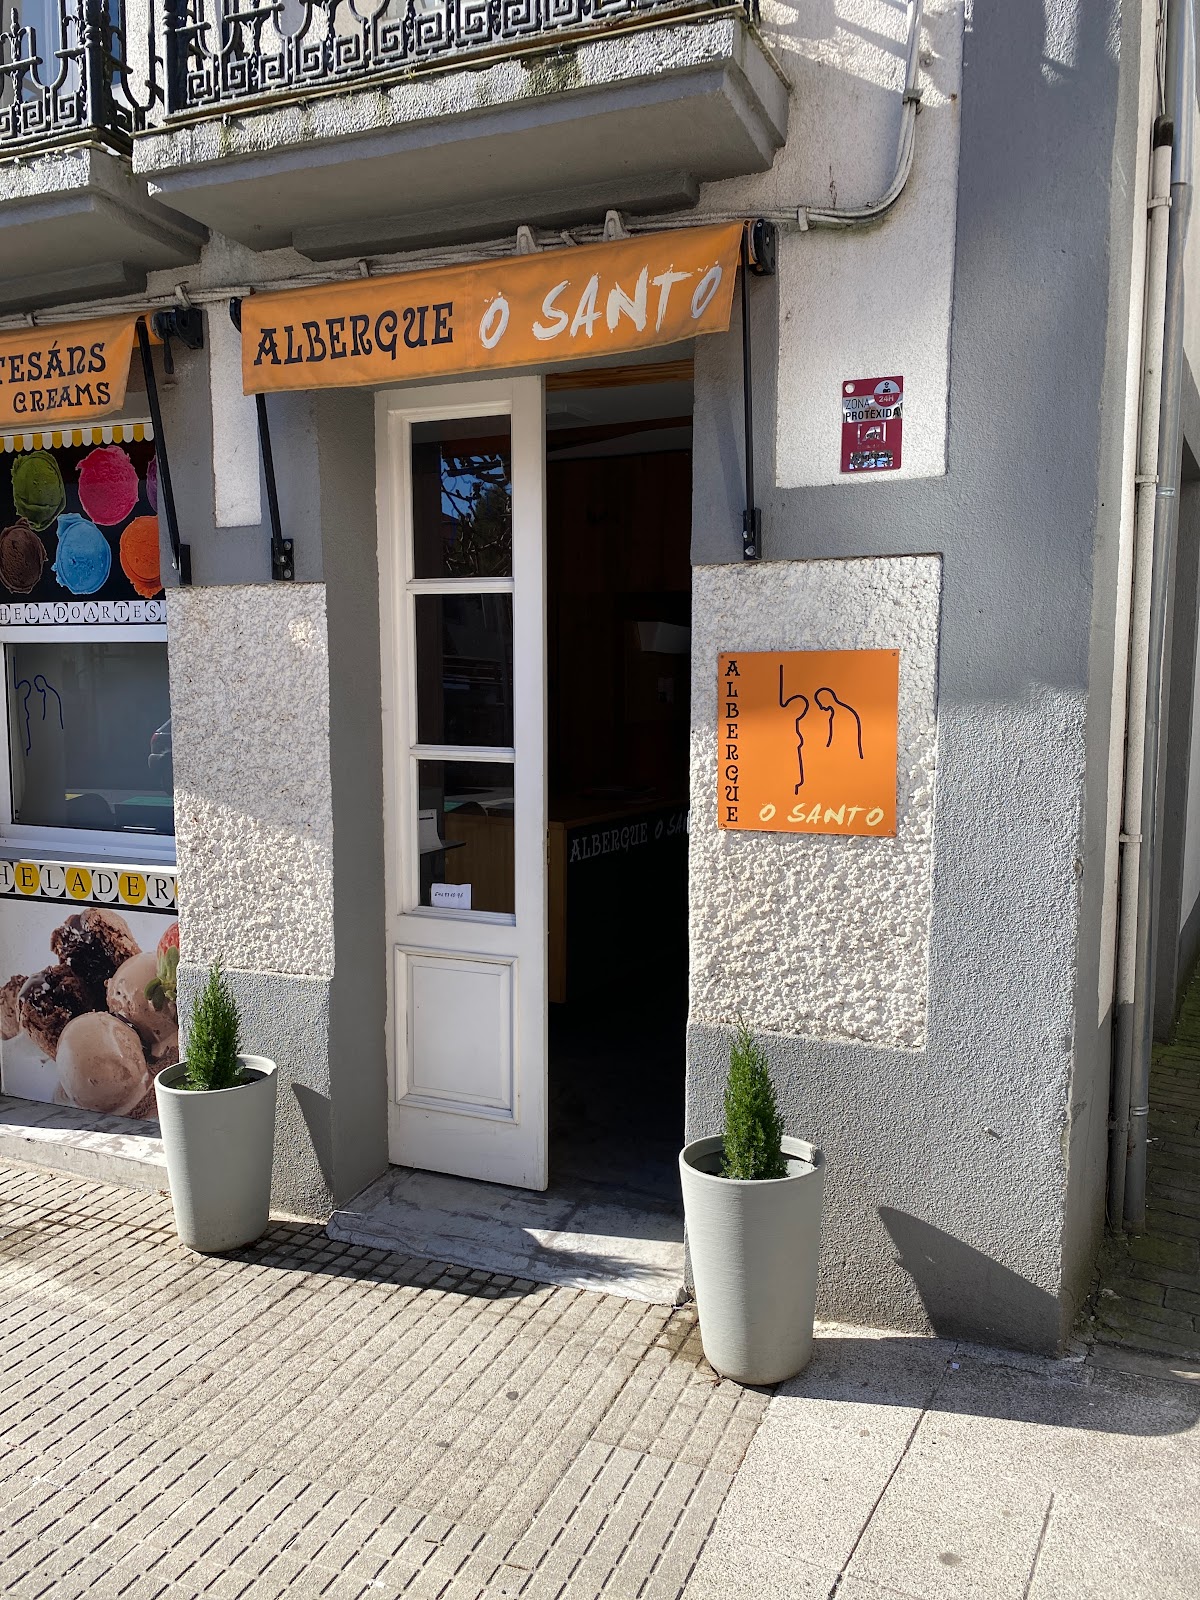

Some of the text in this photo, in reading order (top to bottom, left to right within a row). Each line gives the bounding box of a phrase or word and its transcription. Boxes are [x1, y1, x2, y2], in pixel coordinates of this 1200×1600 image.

[253, 261, 723, 366] ALBERGUE O SANTO
[13, 382, 111, 413] CREAMS
[845, 398, 870, 410] ZONA
[879, 395, 894, 403] 24H
[845, 407, 900, 422] PROTEXIDA
[725, 660, 741, 822] ALBERGUE
[759, 802, 885, 827] O SANTO
[569, 822, 648, 863] ALBERGUE
[654, 819, 664, 840] O
[0, 865, 171, 900] HELADER
